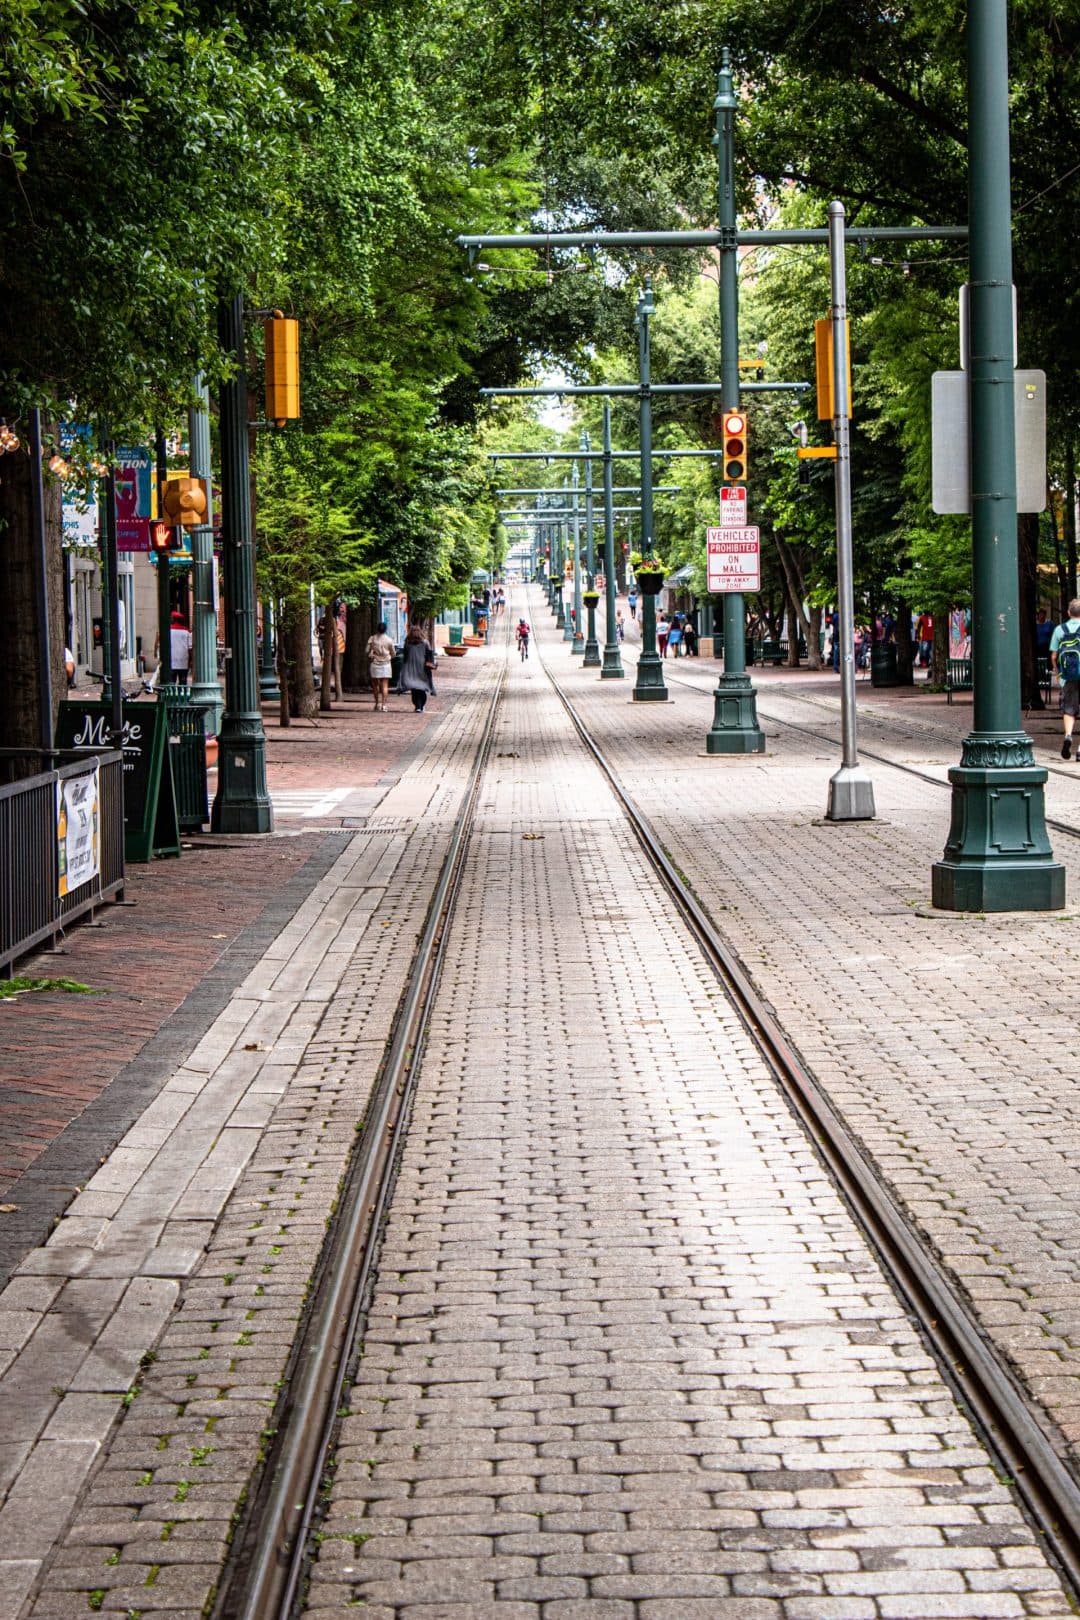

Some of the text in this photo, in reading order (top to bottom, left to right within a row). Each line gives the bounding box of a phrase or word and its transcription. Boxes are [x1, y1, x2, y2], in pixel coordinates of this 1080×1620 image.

[711, 531, 756, 541] VEHICLES
[710, 543, 756, 552] PROHIBITED
[728, 555, 739, 563] ON
[722, 565, 744, 573] MALL
